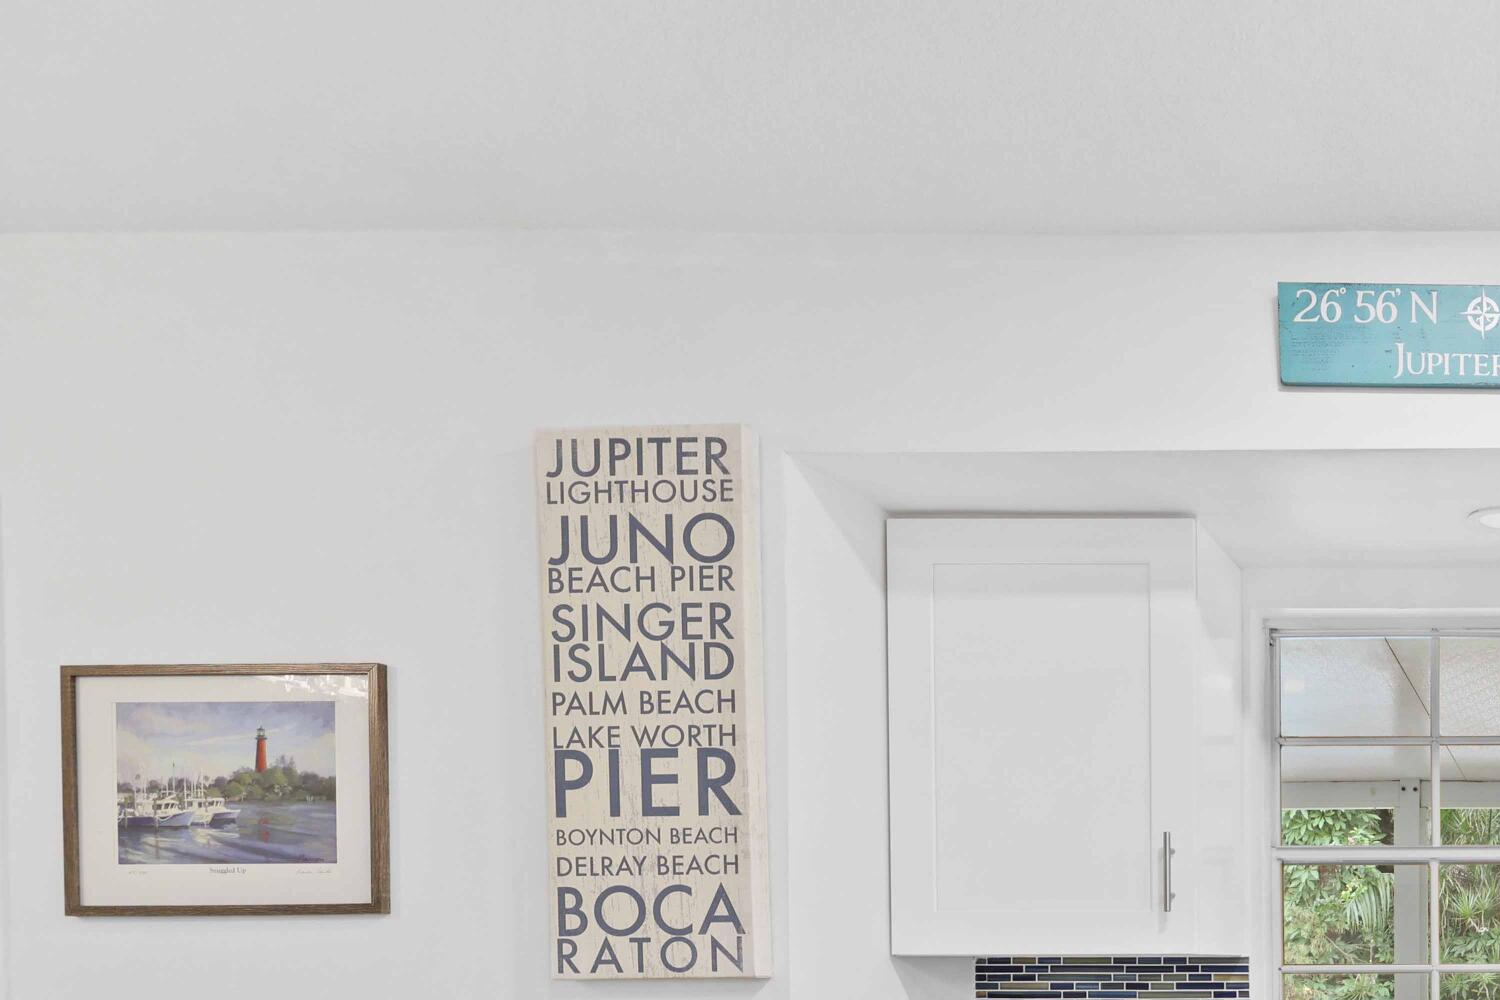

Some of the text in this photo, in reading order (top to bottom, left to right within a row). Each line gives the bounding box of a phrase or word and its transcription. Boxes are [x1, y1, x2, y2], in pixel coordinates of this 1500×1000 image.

[1410, 289, 1438, 325] N
[546, 436, 731, 478] JUPITER
[546, 479, 734, 504] LIGHTHOUSE
[547, 511, 735, 566] JUNO
[548, 565, 735, 593] BEACH PIER
[551, 602, 734, 643] SINGER
[553, 641, 735, 683] ISLAND
[552, 689, 736, 716] PALM BEACH
[553, 724, 736, 748] LAKE WORTH
[554, 747, 743, 818] PIER
[555, 826, 738, 846] BOYNTON BEACH
[556, 854, 739, 877] DELRAY BEACH
[557, 882, 746, 937] BOCA
[557, 934, 744, 974] RATON
